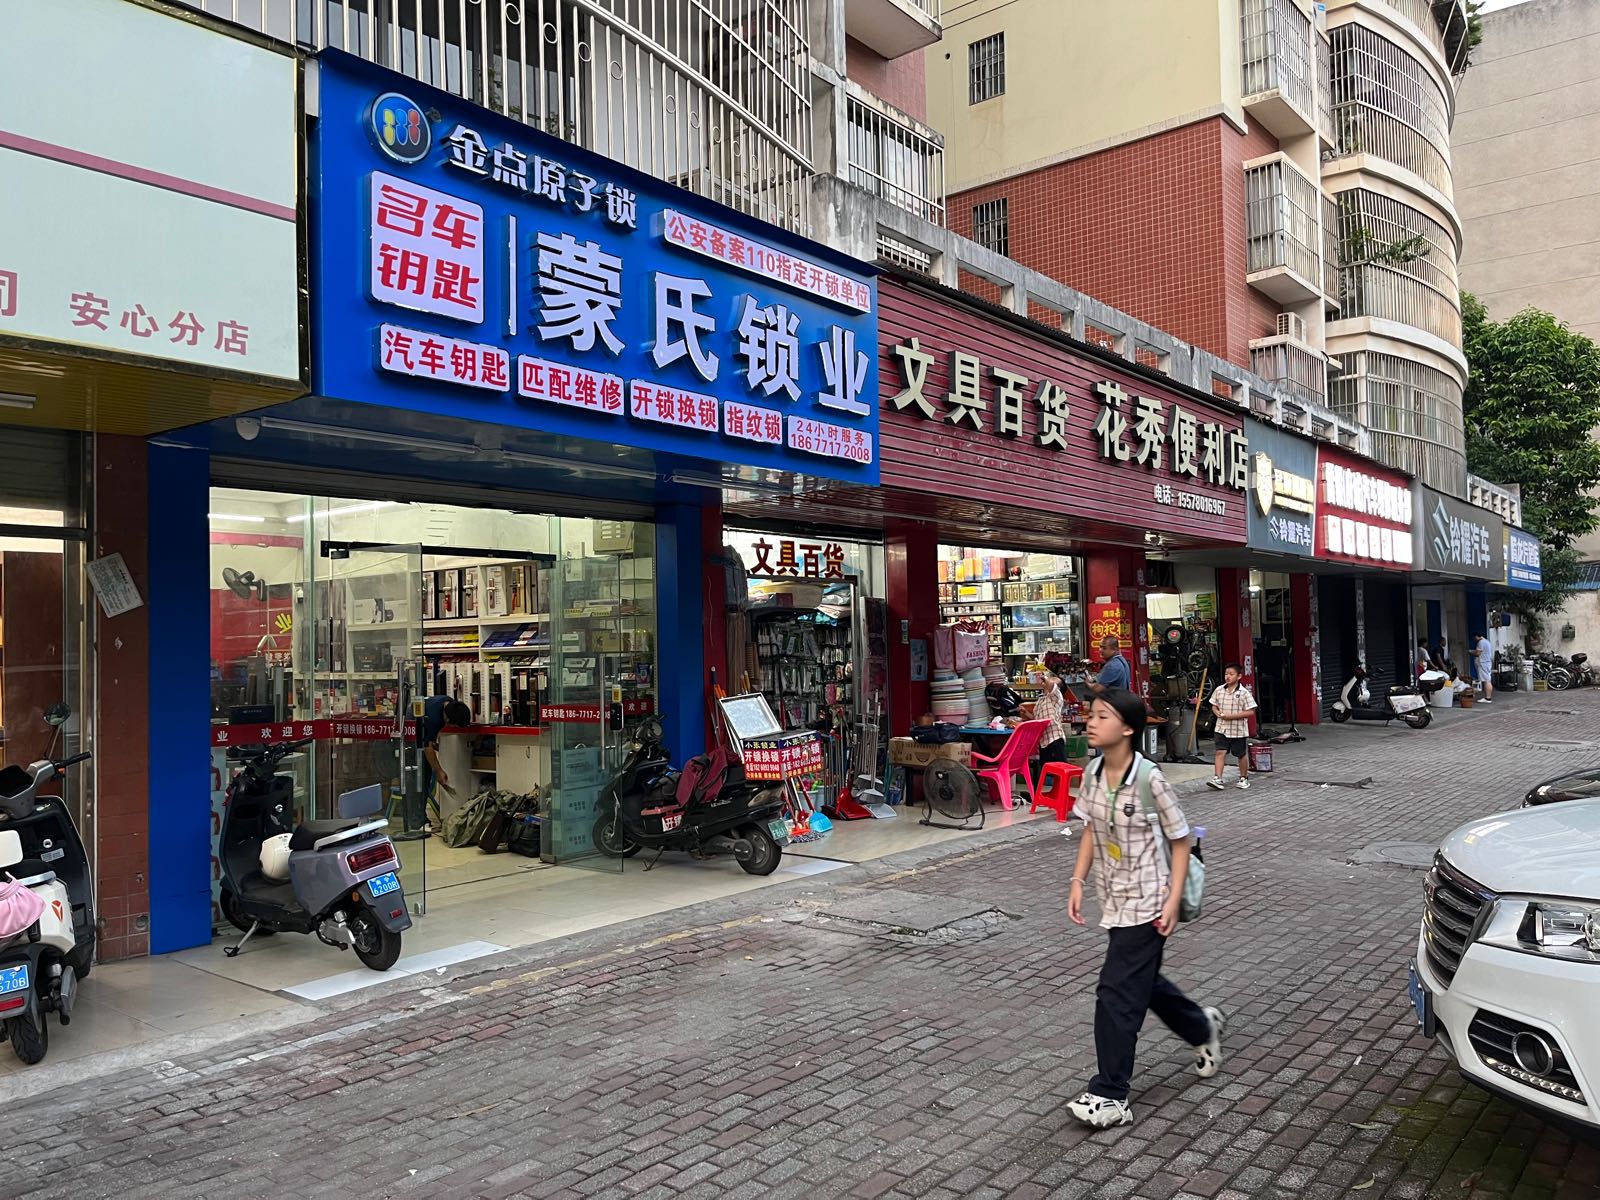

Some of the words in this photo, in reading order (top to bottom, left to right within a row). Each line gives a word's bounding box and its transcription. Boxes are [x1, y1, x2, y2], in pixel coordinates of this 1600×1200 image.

[447, 124, 638, 229] 金点原子锁
[376, 184, 481, 250] 名车
[376, 241, 481, 311] 钥匙
[667, 215, 871, 310] 公安备案110指定开锁单位
[69, 291, 250, 356] 安心分店
[536, 231, 871, 416] 蒙氏锁业
[383, 329, 510, 389] 汽车钥匙
[522, 361, 623, 411] 匹配维修
[632, 385, 719, 430] 开锁换锁
[892, 336, 1071, 451] 文具百货
[727, 408, 782, 441] 指纹锁
[796, 419, 865, 447] 24小时服务
[1094, 380, 1250, 491] 花秀便利店
[750, 537, 845, 578] 文具百货
[1450, 515, 1491, 569] 铃耀汽车
[336, 723, 363, 735] 开锁换锁
[541, 708, 565, 719] 配车钥匙
[565, 709, 611, 719] 186-7717-208
[744, 751, 779, 762] 开锁换锁
[781, 743, 820, 762] 开锁锁
[783, 735, 817, 747] 小张业
[373, 881, 398, 895] 6200R
